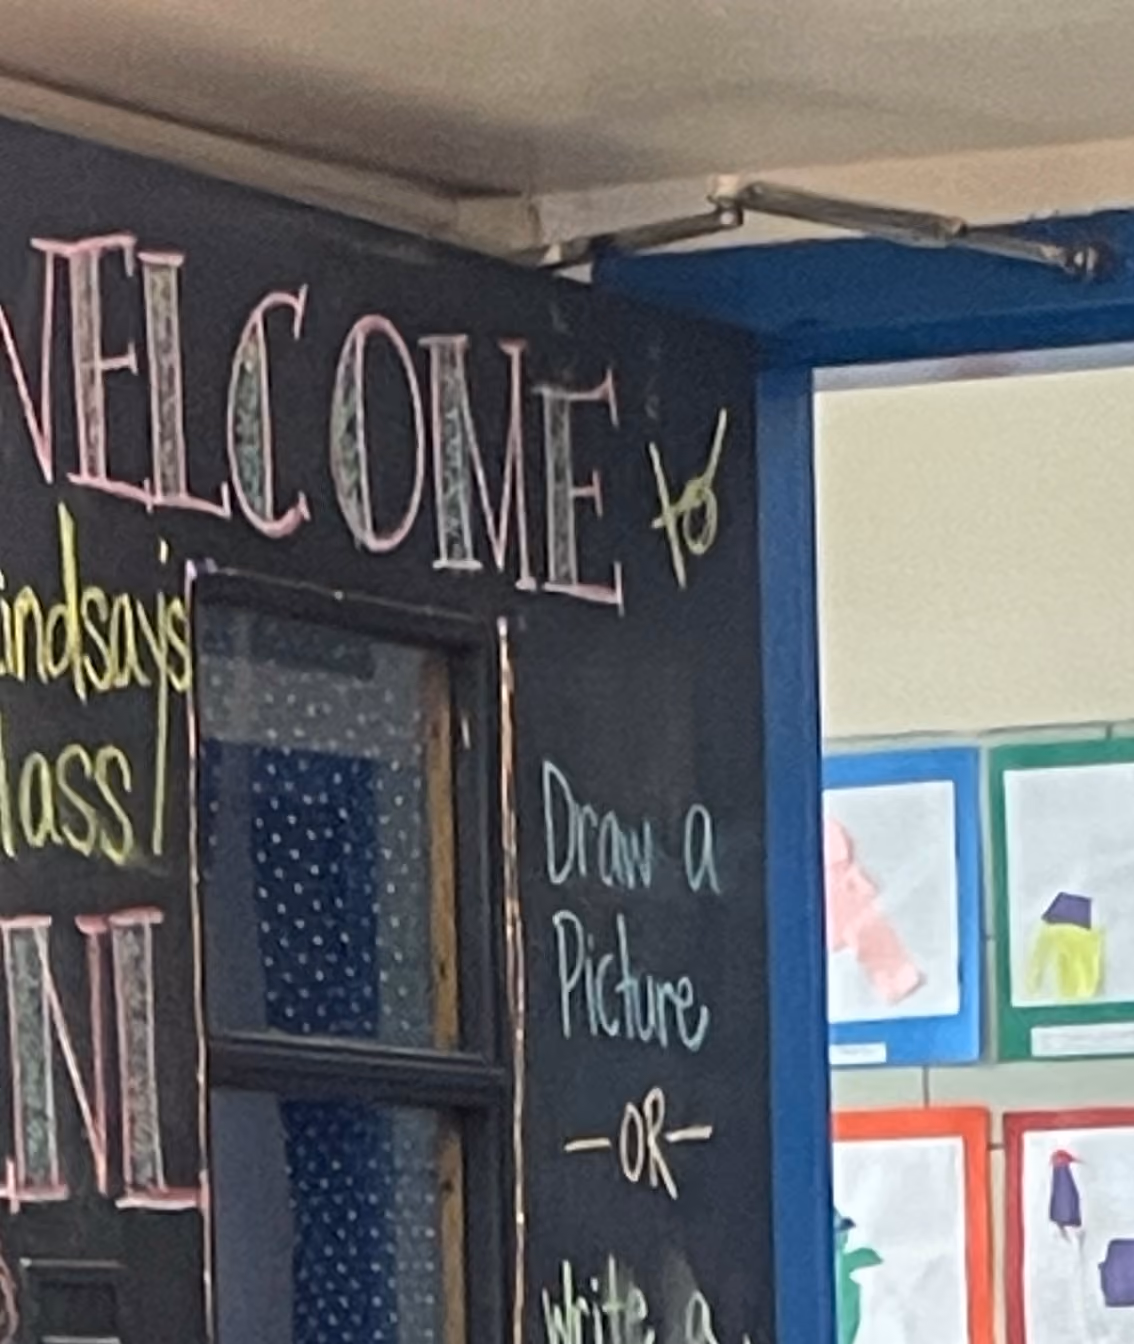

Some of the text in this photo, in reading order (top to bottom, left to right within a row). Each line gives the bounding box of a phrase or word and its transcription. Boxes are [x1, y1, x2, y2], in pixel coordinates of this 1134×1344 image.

[650, 407, 729, 590] to
[0, 715, 136, 866] lass
[541, 758, 722, 896] Draw a
[551, 909, 709, 1051] Picture
